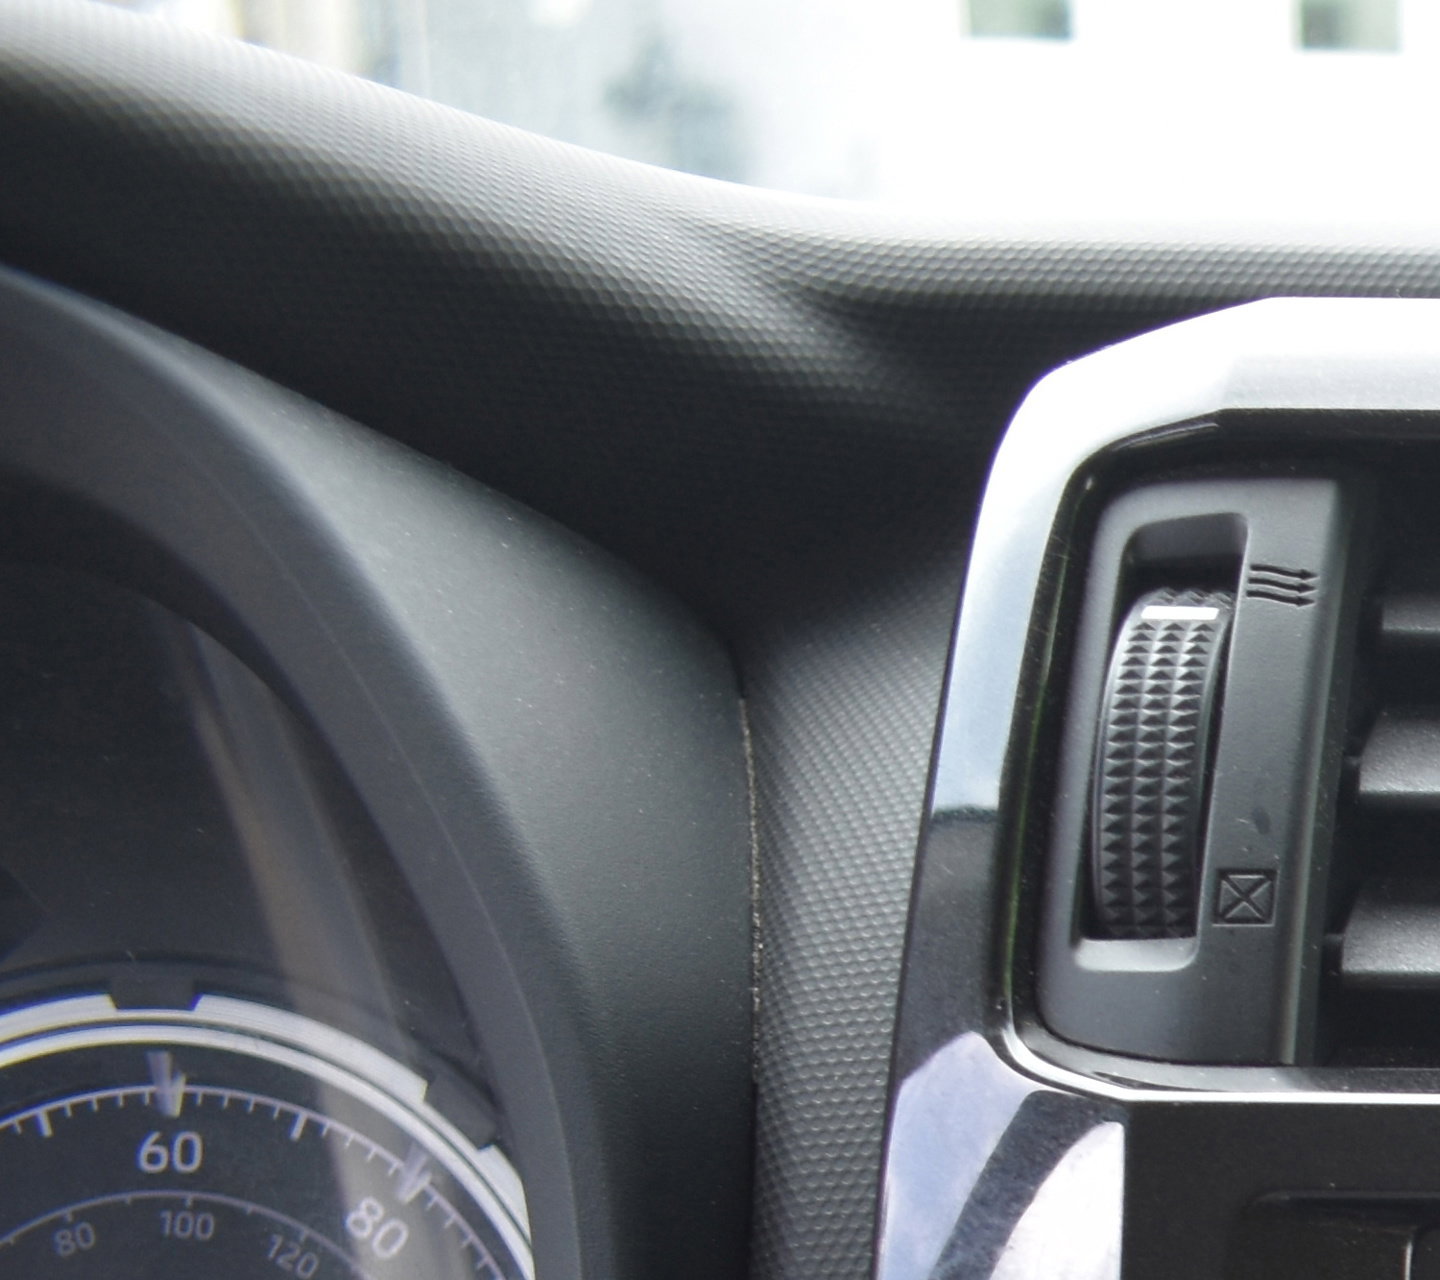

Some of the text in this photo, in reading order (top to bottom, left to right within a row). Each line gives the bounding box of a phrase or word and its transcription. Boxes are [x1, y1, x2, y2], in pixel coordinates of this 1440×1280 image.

[138, 1130, 203, 1174] 60
[53, 1221, 96, 1258] 80
[159, 1210, 215, 1241] 100
[346, 1196, 409, 1259] 80
[268, 1233, 320, 1280] 120
